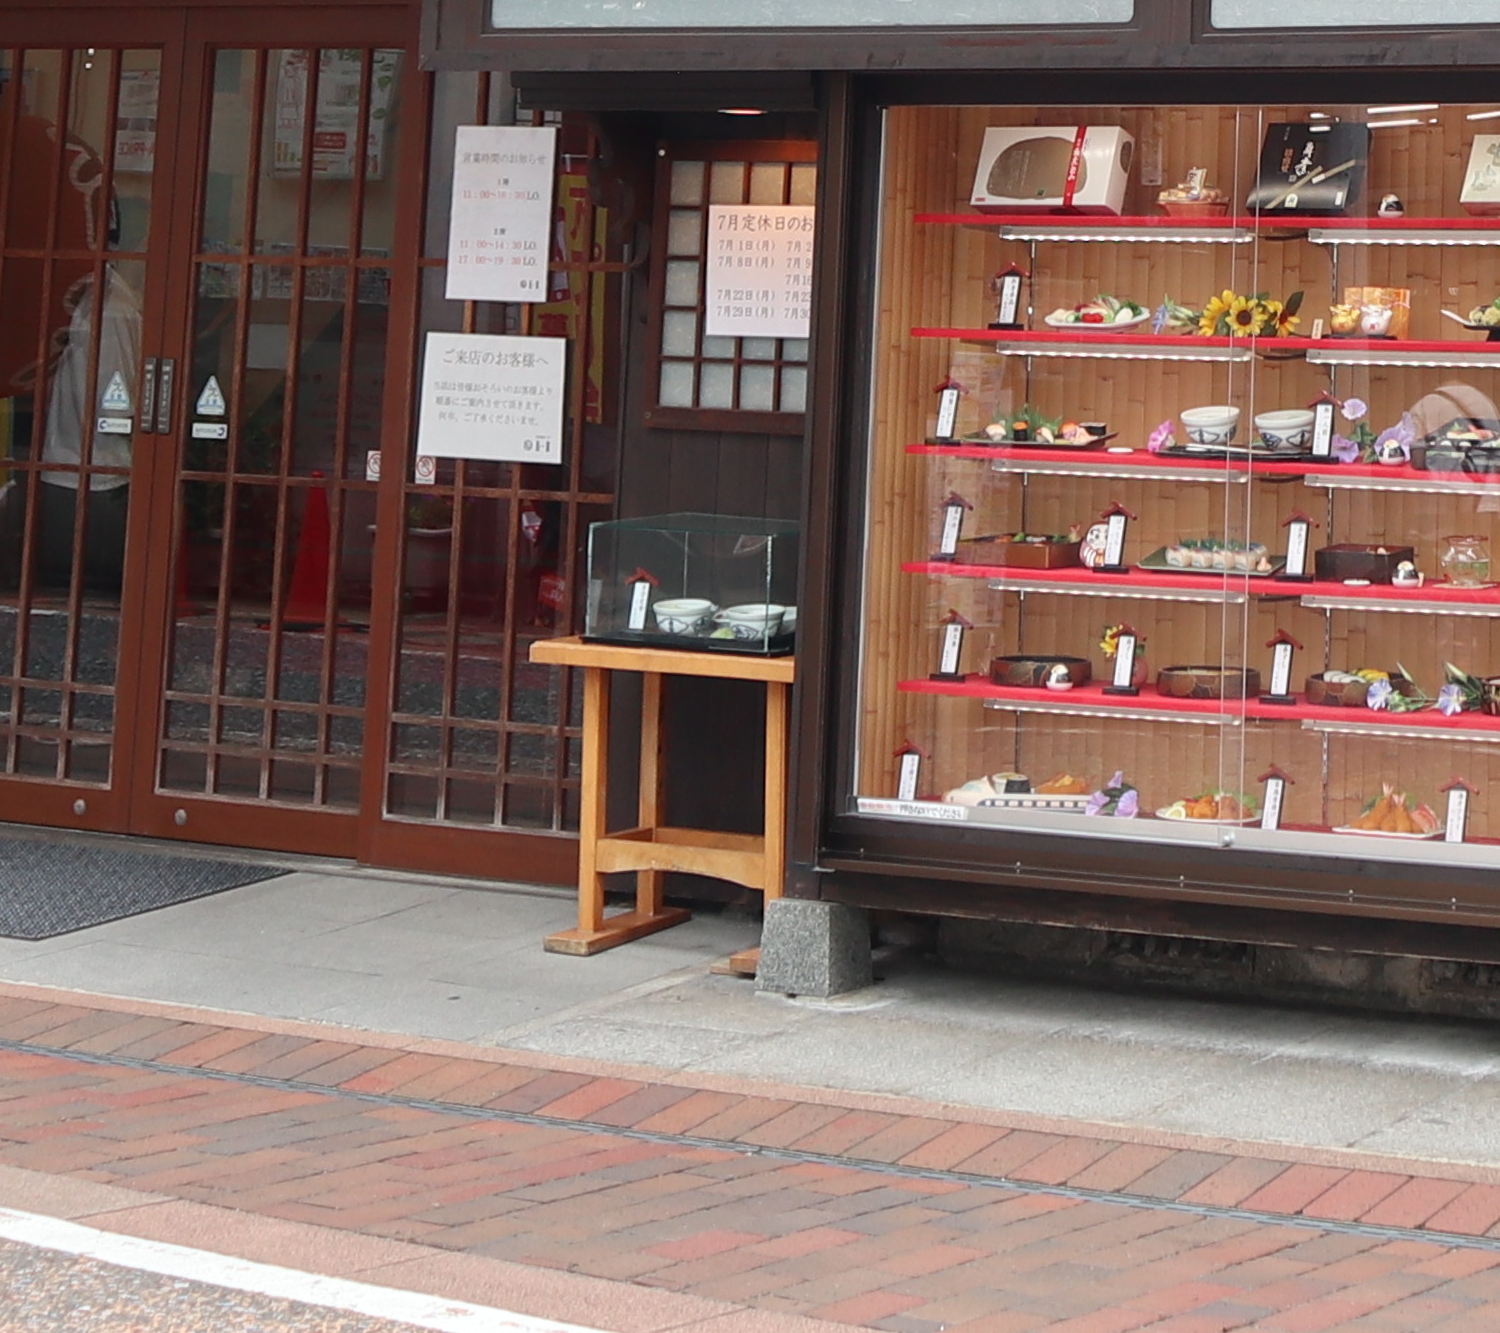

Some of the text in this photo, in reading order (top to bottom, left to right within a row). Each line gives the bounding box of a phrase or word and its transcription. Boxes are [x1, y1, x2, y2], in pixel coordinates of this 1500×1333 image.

[442, 349, 549, 368] ご来店のお客様へ
